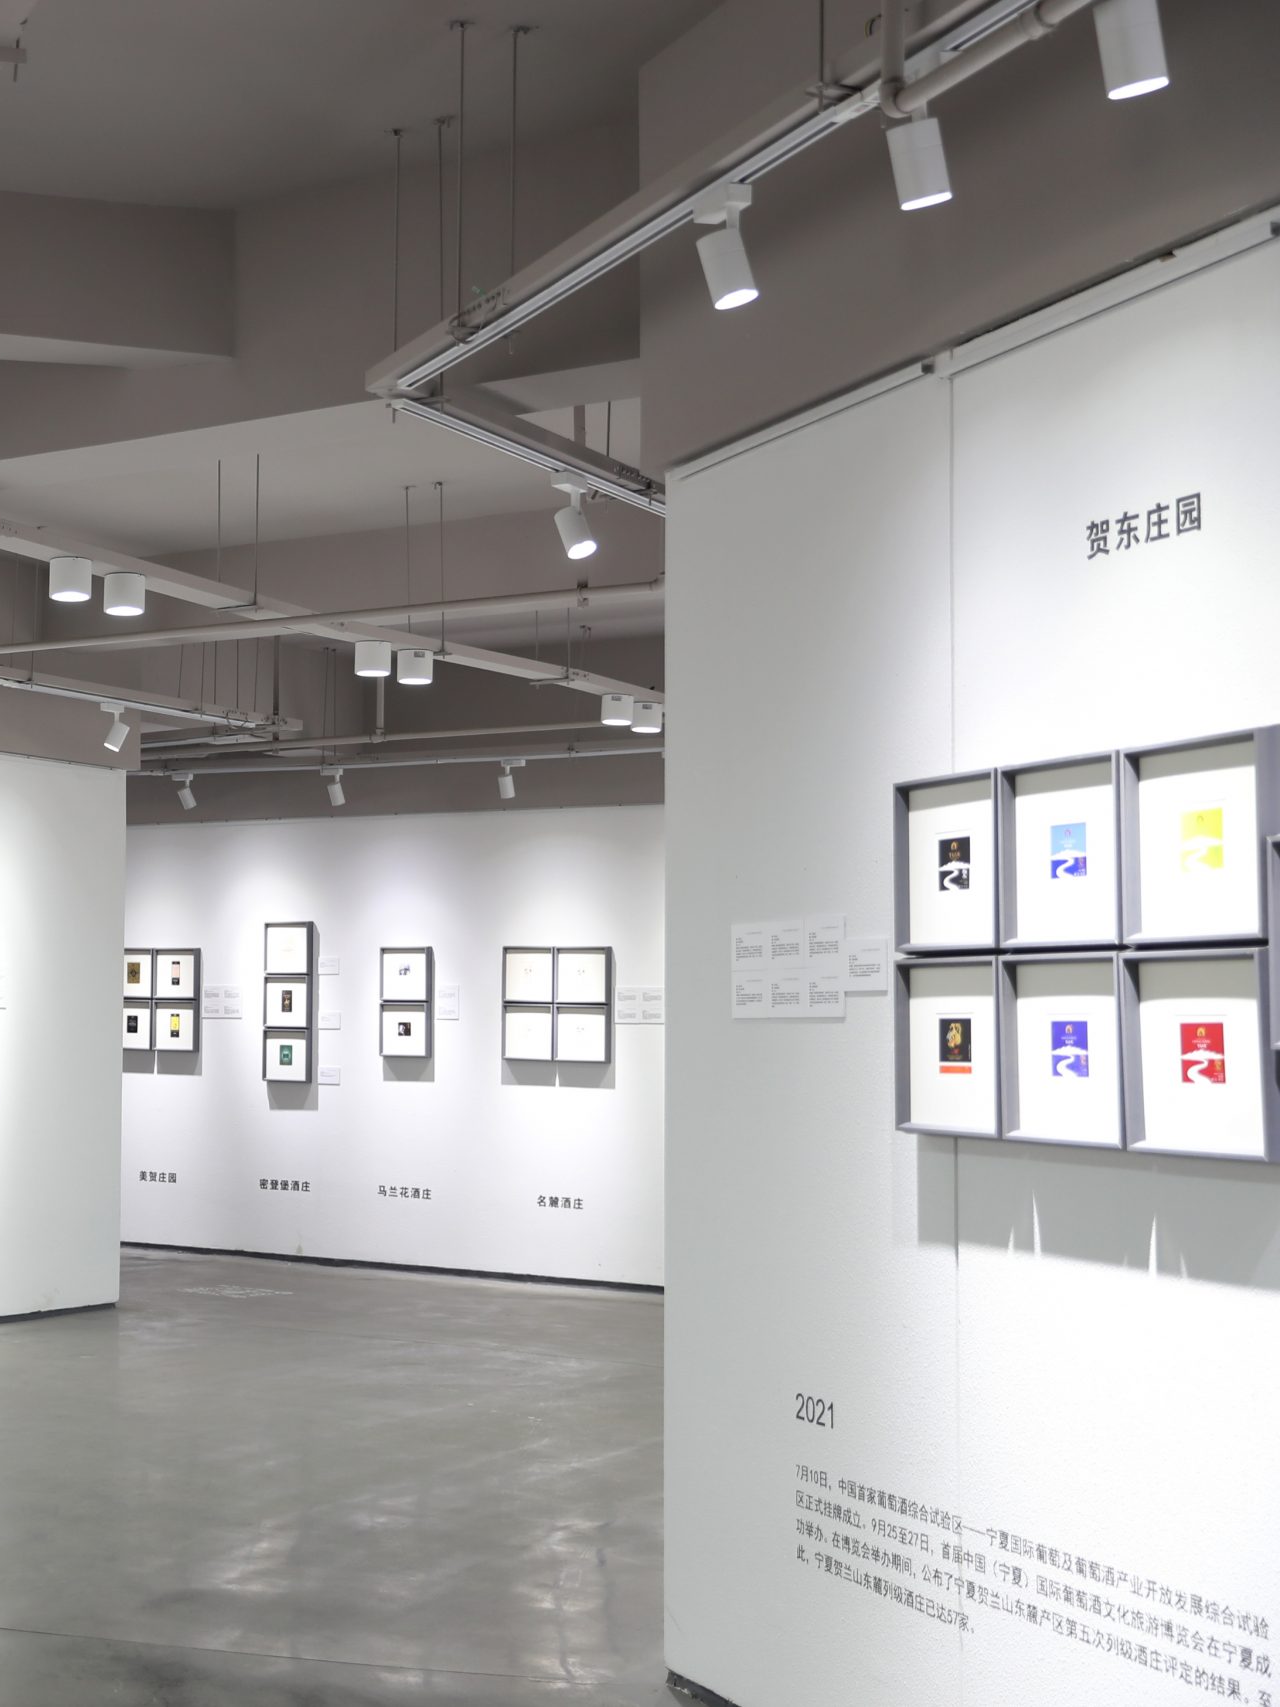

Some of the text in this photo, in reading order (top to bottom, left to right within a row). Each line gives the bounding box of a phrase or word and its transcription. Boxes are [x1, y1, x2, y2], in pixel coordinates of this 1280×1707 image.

[1085, 491, 1202, 561] 贺东庄园
[138, 1169, 177, 1184] 美贺庄园
[258, 1178, 311, 1193] 密登堡酒庄
[377, 1184, 432, 1201] 马兰花酒庄
[536, 1194, 584, 1210] 名麓酒庄
[795, 1392, 834, 1430] 2021
